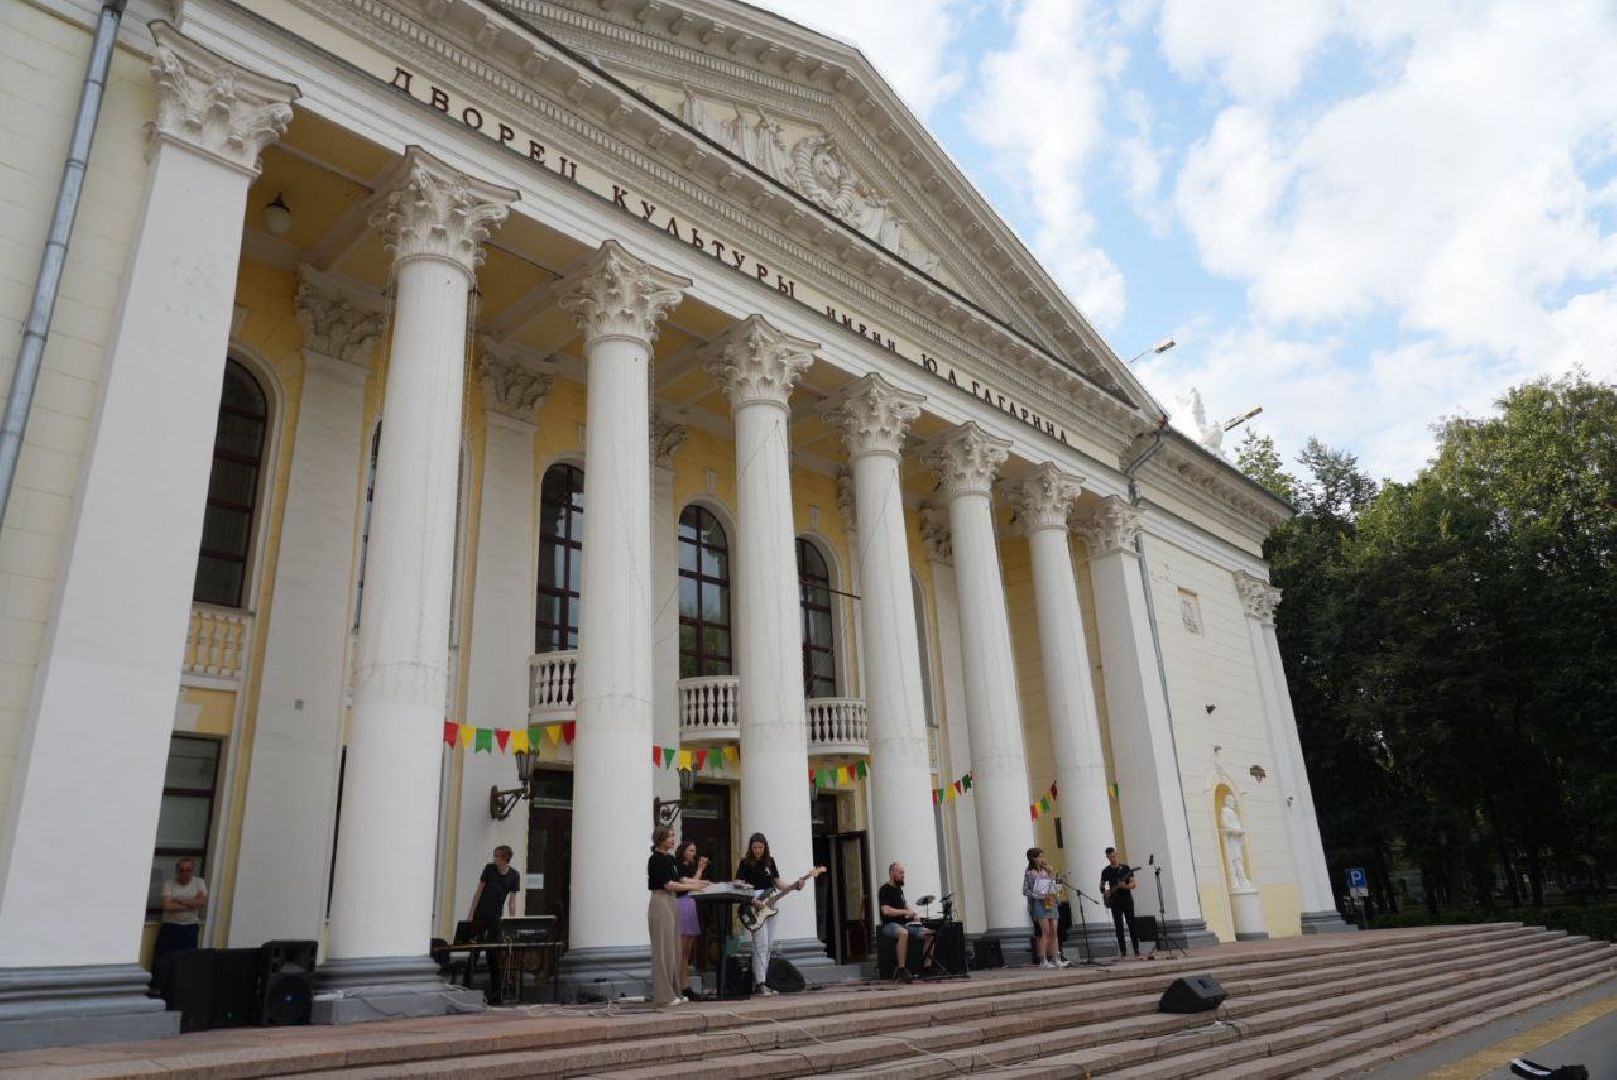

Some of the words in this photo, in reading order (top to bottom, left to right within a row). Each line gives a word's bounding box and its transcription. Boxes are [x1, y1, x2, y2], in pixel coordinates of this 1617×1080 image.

[390, 67, 577, 184] ДВОРЕЦ
[612, 185, 795, 298] КУЛЬТУРЫ
[826, 306, 896, 353] ИМЕНИ
[972, 381, 1068, 444] ГАГАРИНА
[1350, 870, 1361, 885] P
